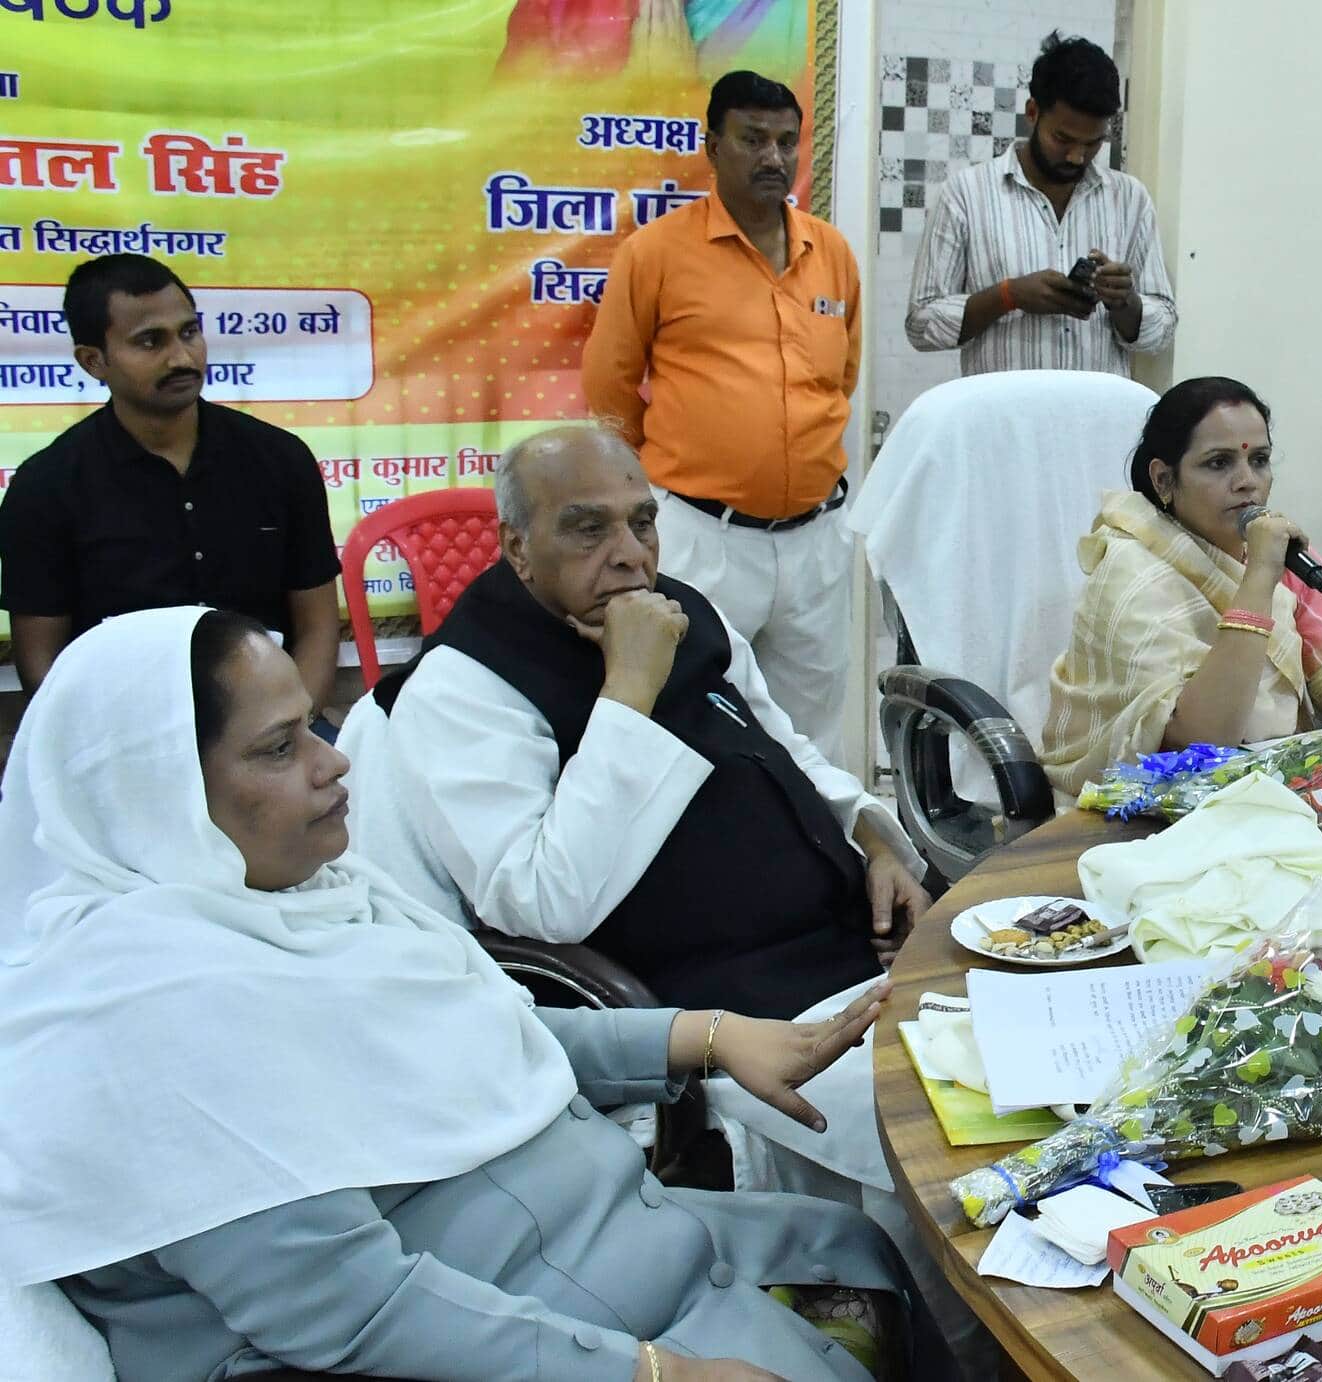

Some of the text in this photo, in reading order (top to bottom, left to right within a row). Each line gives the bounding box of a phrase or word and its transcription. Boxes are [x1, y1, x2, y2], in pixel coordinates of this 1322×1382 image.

[144, 134, 284, 195] सिंह
[486, 174, 615, 232] जिला
[33, 219, 226, 256] सिद्धार्थनगर
[216, 312, 287, 335] 12:30
[298, 304, 340, 334] बजे
[371, 456, 448, 485] कुमार
